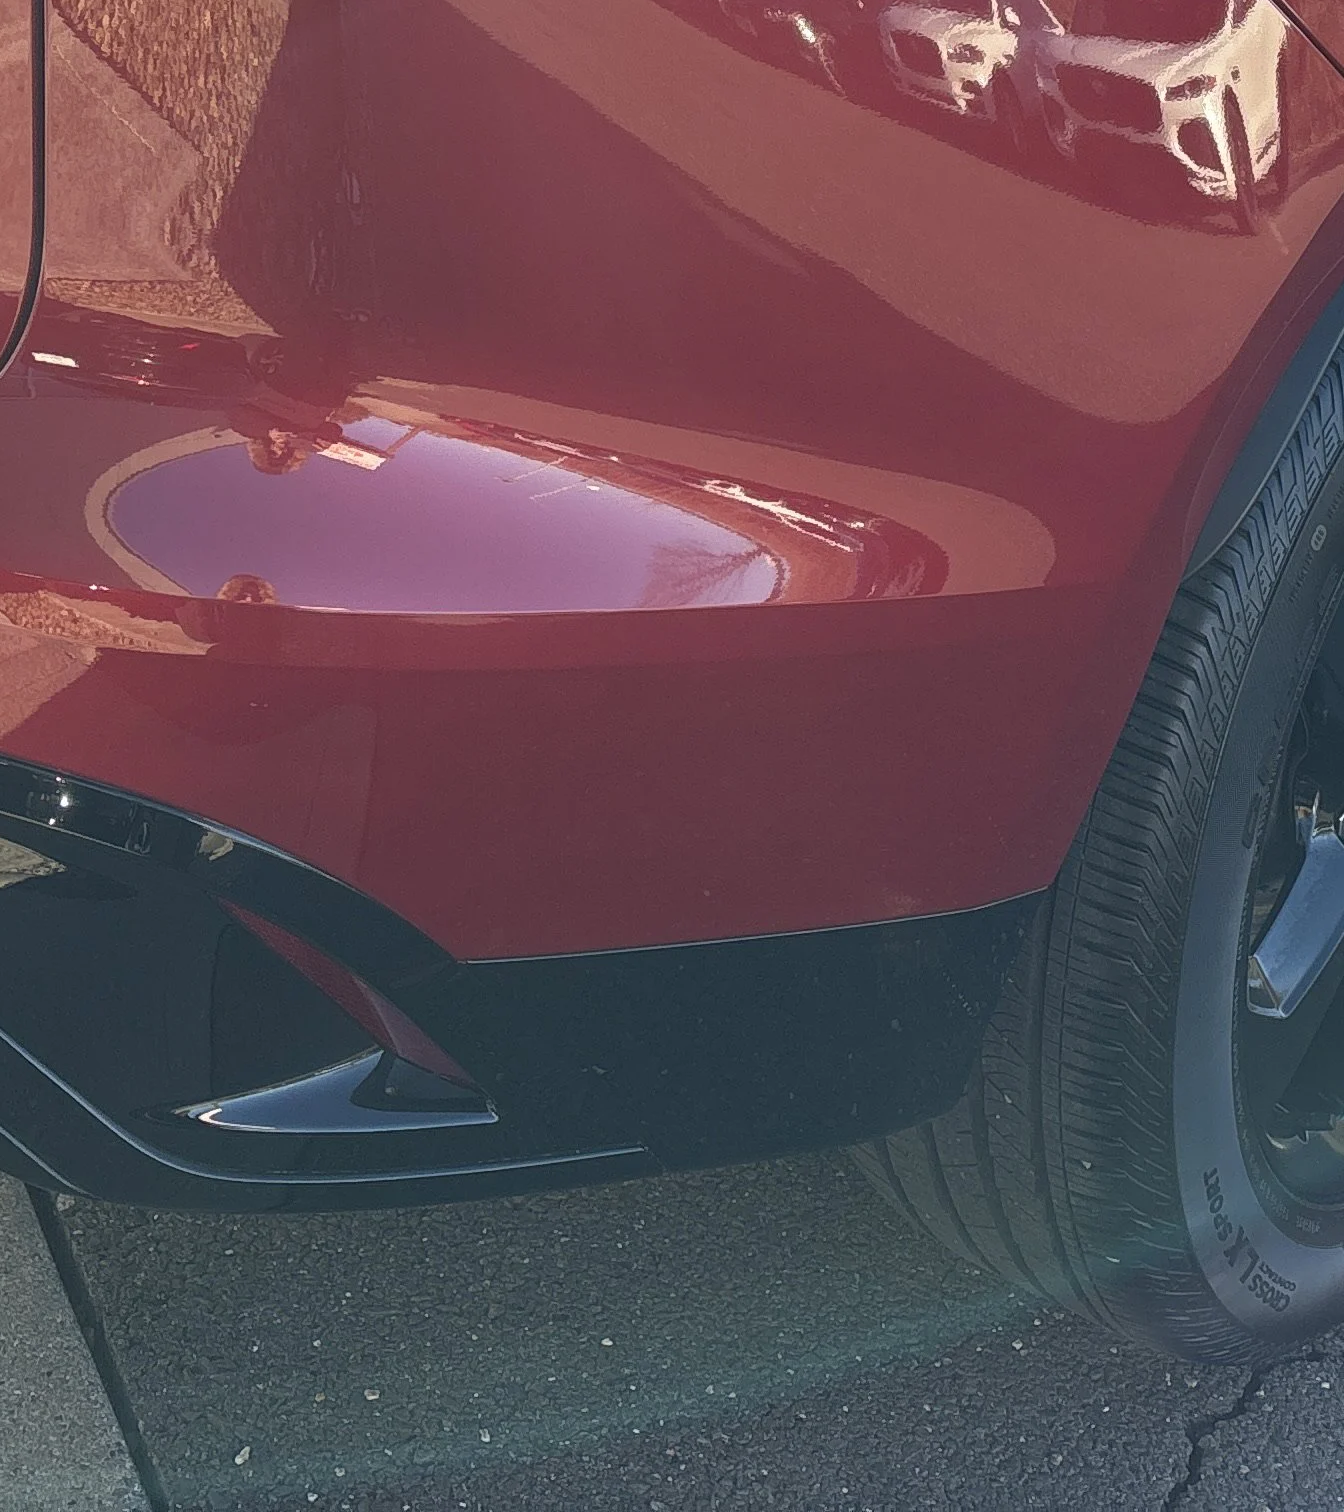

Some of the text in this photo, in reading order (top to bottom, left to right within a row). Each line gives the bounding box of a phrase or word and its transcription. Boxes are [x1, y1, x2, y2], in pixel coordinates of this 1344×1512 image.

[1203, 1167, 1290, 1312] CROSS LX SPORT
